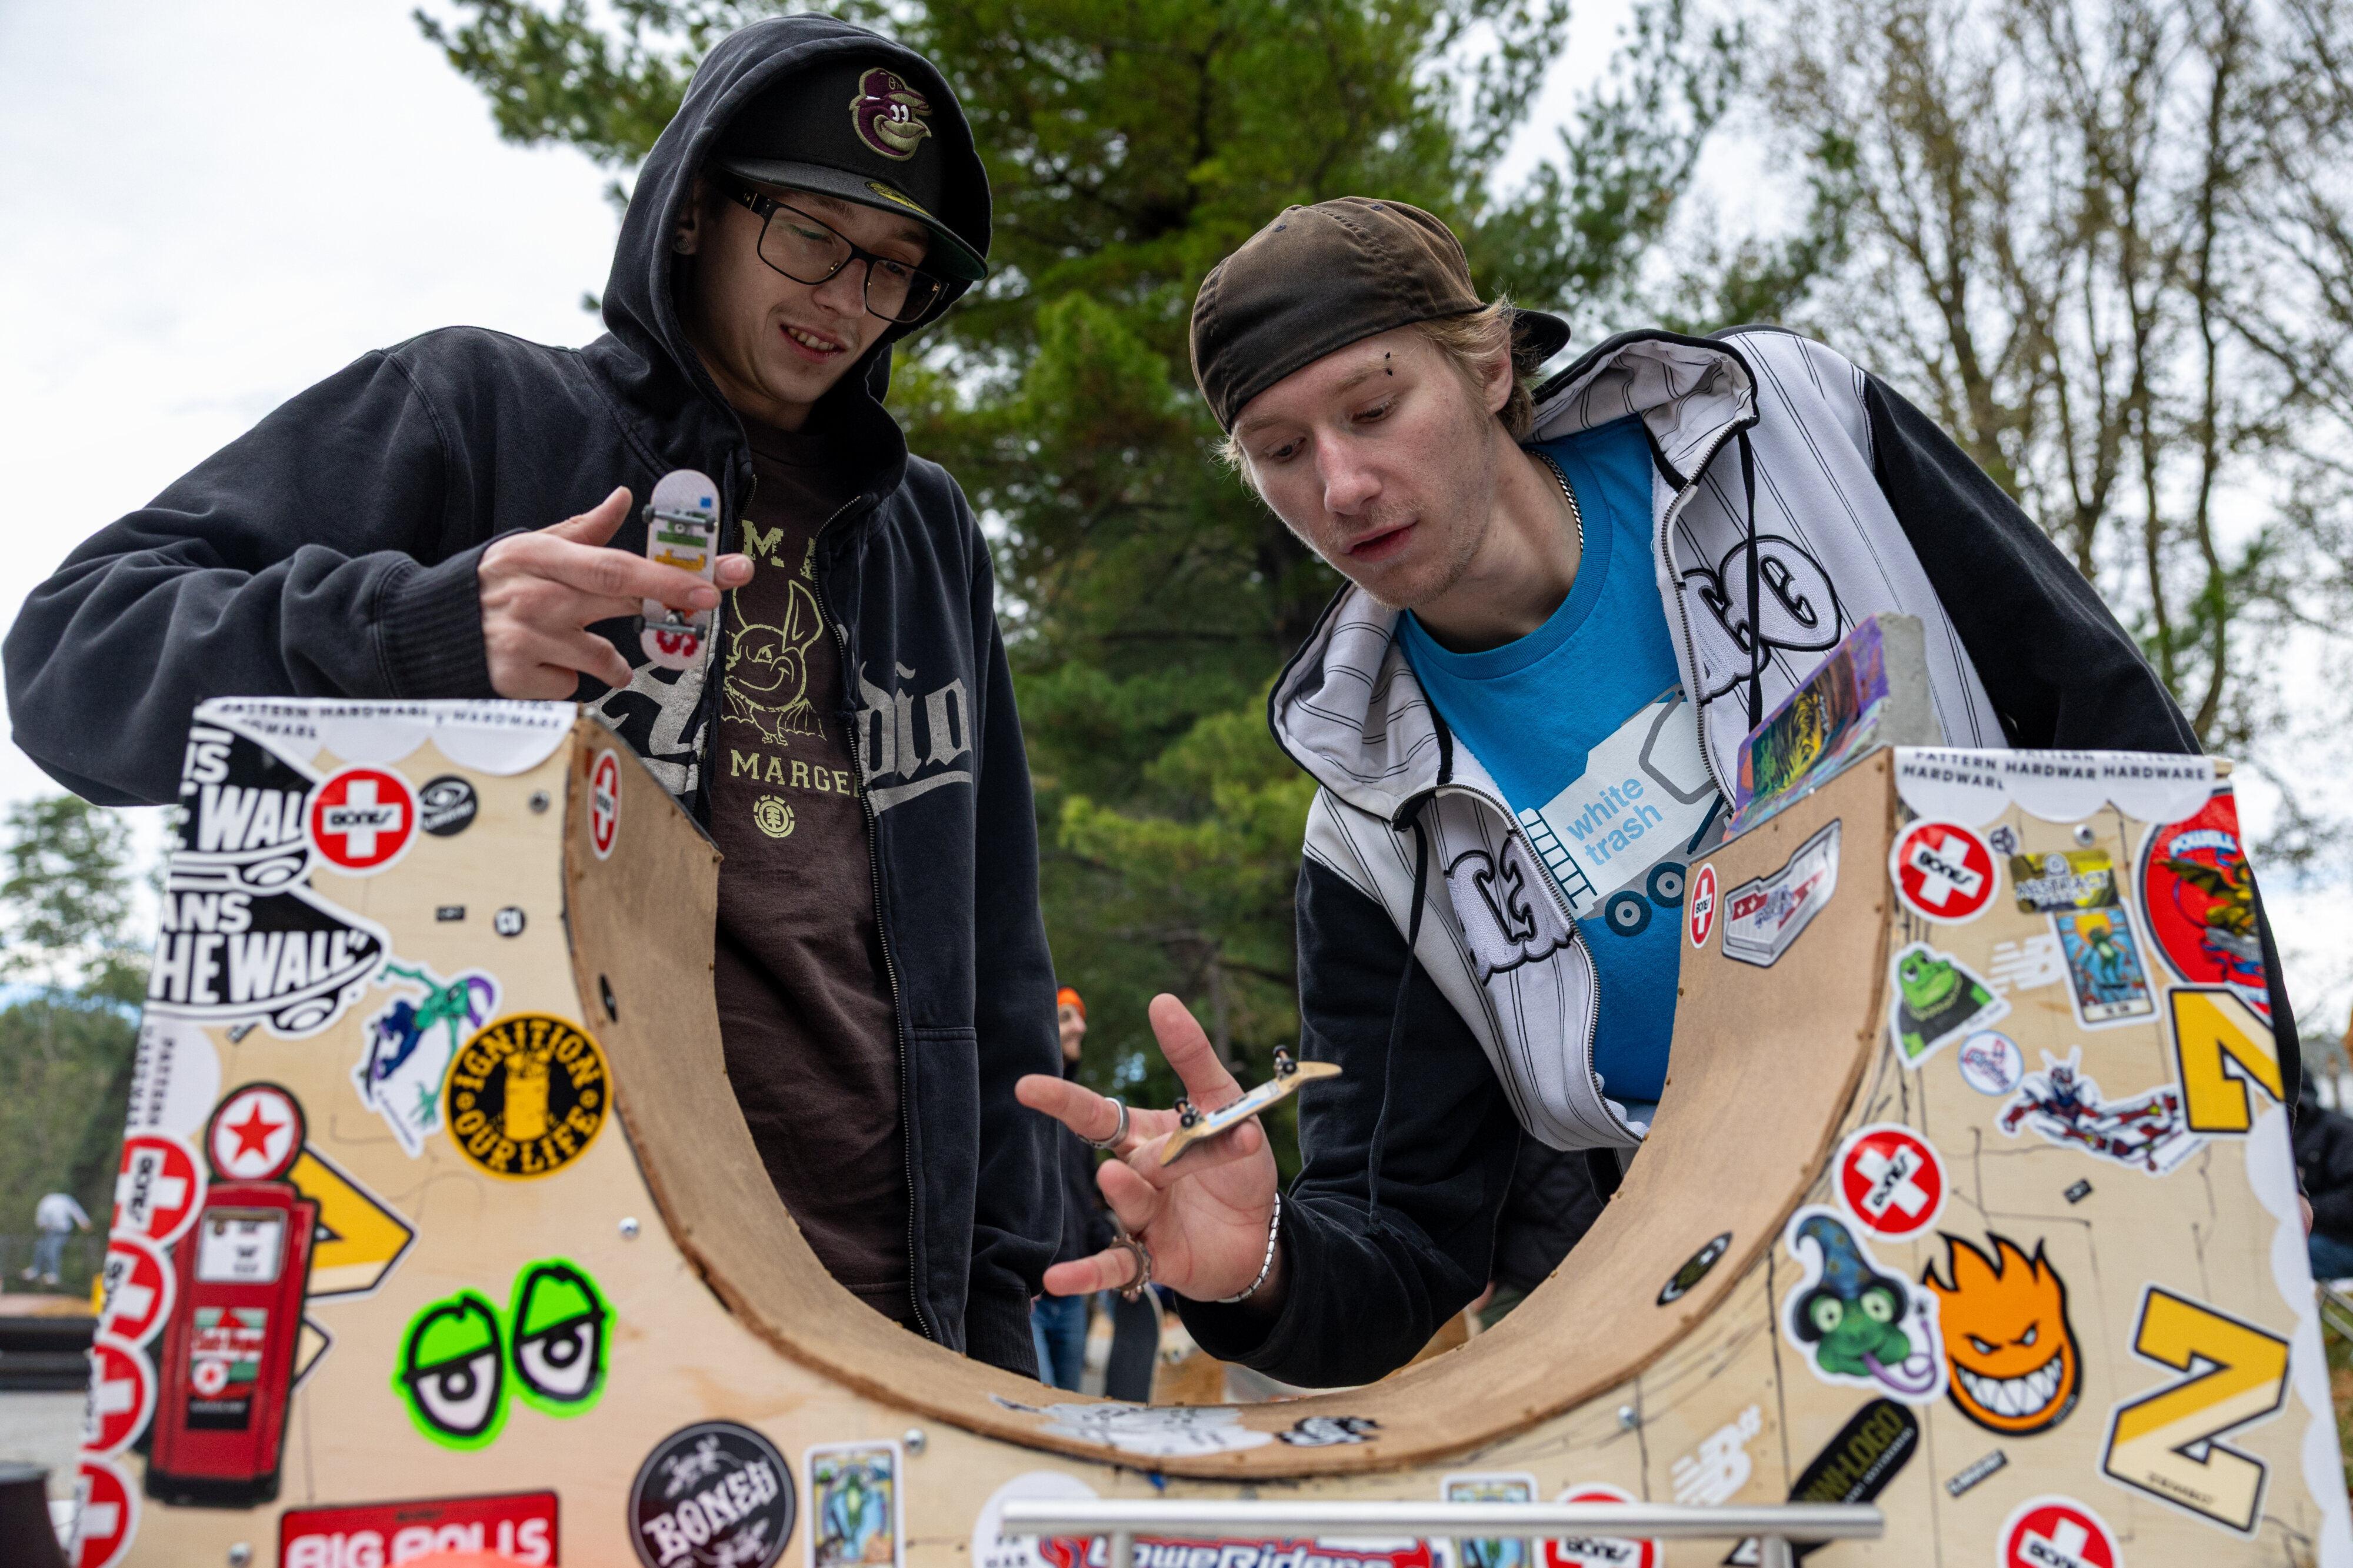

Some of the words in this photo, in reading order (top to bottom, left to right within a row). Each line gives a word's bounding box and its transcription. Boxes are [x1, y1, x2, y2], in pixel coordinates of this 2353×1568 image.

[1915, 753, 1997, 770] PATTERN
[2104, 766, 2205, 781] HARDWARE
[1566, 779, 1644, 841] white
[1584, 805, 1664, 866] trash
[454, 1020, 602, 1093] IGNITION
[455, 1109, 517, 1172] OUR
[642, 1460, 778, 1566] BONES
[285, 1531, 384, 1568] BIG
